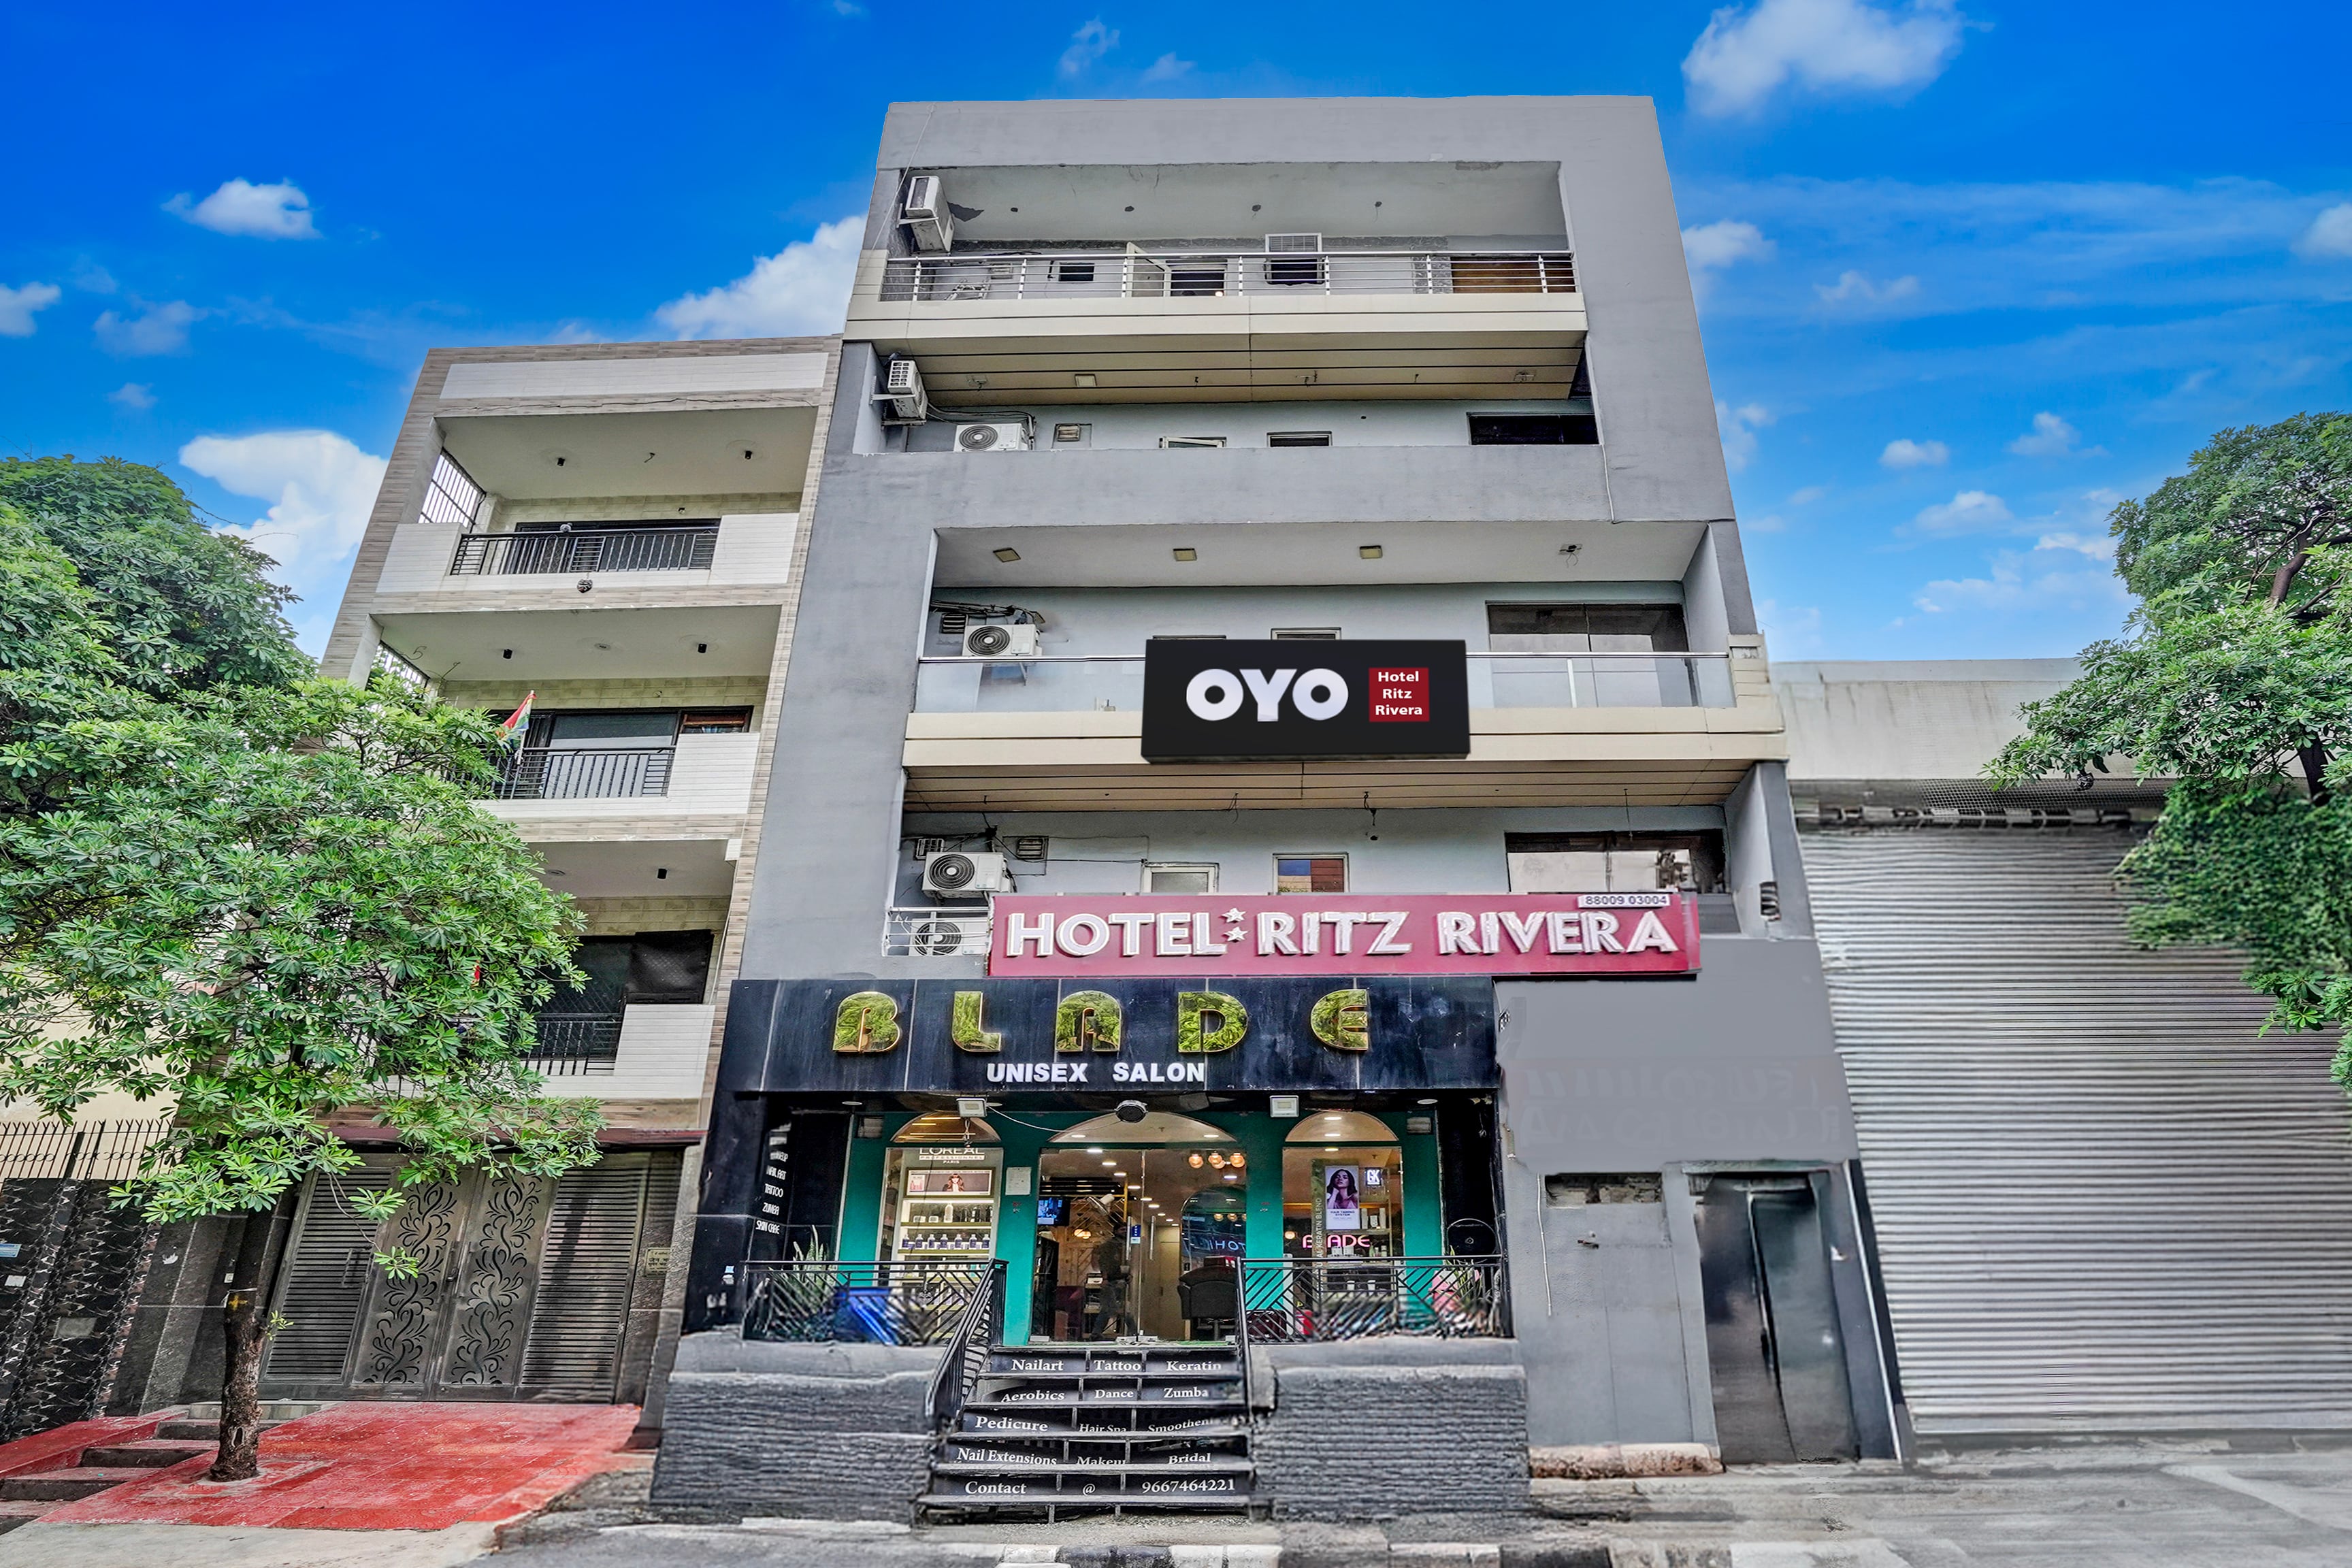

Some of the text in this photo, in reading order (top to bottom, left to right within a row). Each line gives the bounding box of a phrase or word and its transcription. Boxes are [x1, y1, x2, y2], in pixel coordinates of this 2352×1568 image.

[1377, 671, 1420, 683] Hotel
[1186, 668, 1349, 722] OYO
[1382, 687, 1412, 700] Ritz
[1375, 704, 1423, 715] Rivera
[1584, 895, 1667, 906] 88009 03004
[1006, 910, 1680, 958] HOTEL RITZ RIVERA
[832, 988, 1369, 1054] BLADE
[986, 1062, 1205, 1083] UNISEX SALON
[1367, 1169, 1380, 1183] GK
[764, 1183, 783, 1197] TATTOO
[755, 1220, 780, 1234] SKIN CARE
[1303, 1235, 1371, 1249] BADE
[1011, 1359, 1222, 1371] Nailart Tattoo Keratin
[1000, 1386, 1209, 1403] Aerobics Dance Zumba
[975, 1416, 1049, 1432] Pedicure
[1079, 1423, 1105, 1432] Hair
[956, 1448, 985, 1462] Nail
[987, 1450, 1057, 1465] Extensions
[1168, 1452, 1211, 1464] Bridal
[965, 1478, 1235, 1495] Contact @ 9667464221
